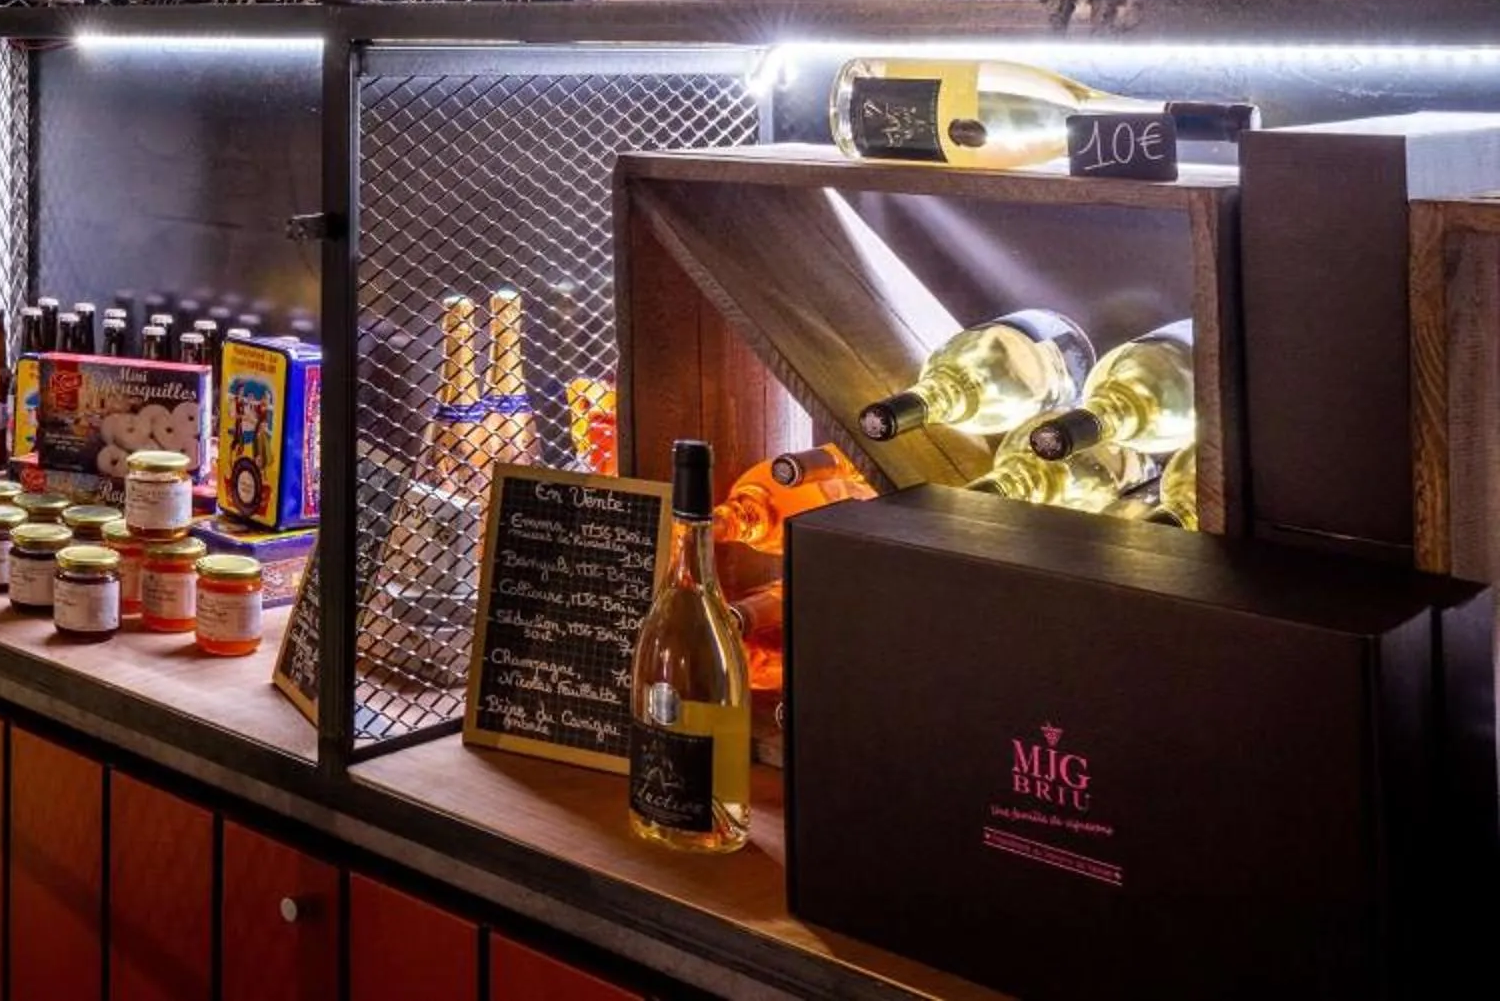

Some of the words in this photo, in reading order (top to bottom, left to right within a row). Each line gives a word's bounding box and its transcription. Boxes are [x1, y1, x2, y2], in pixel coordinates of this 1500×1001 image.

[1075, 118, 1167, 171] 10€
[120, 367, 148, 382] Mini
[535, 482, 563, 504] En
[619, 553, 655, 571] 13€
[1011, 738, 1092, 791] MJG
[1011, 773, 1092, 812] BRIU
